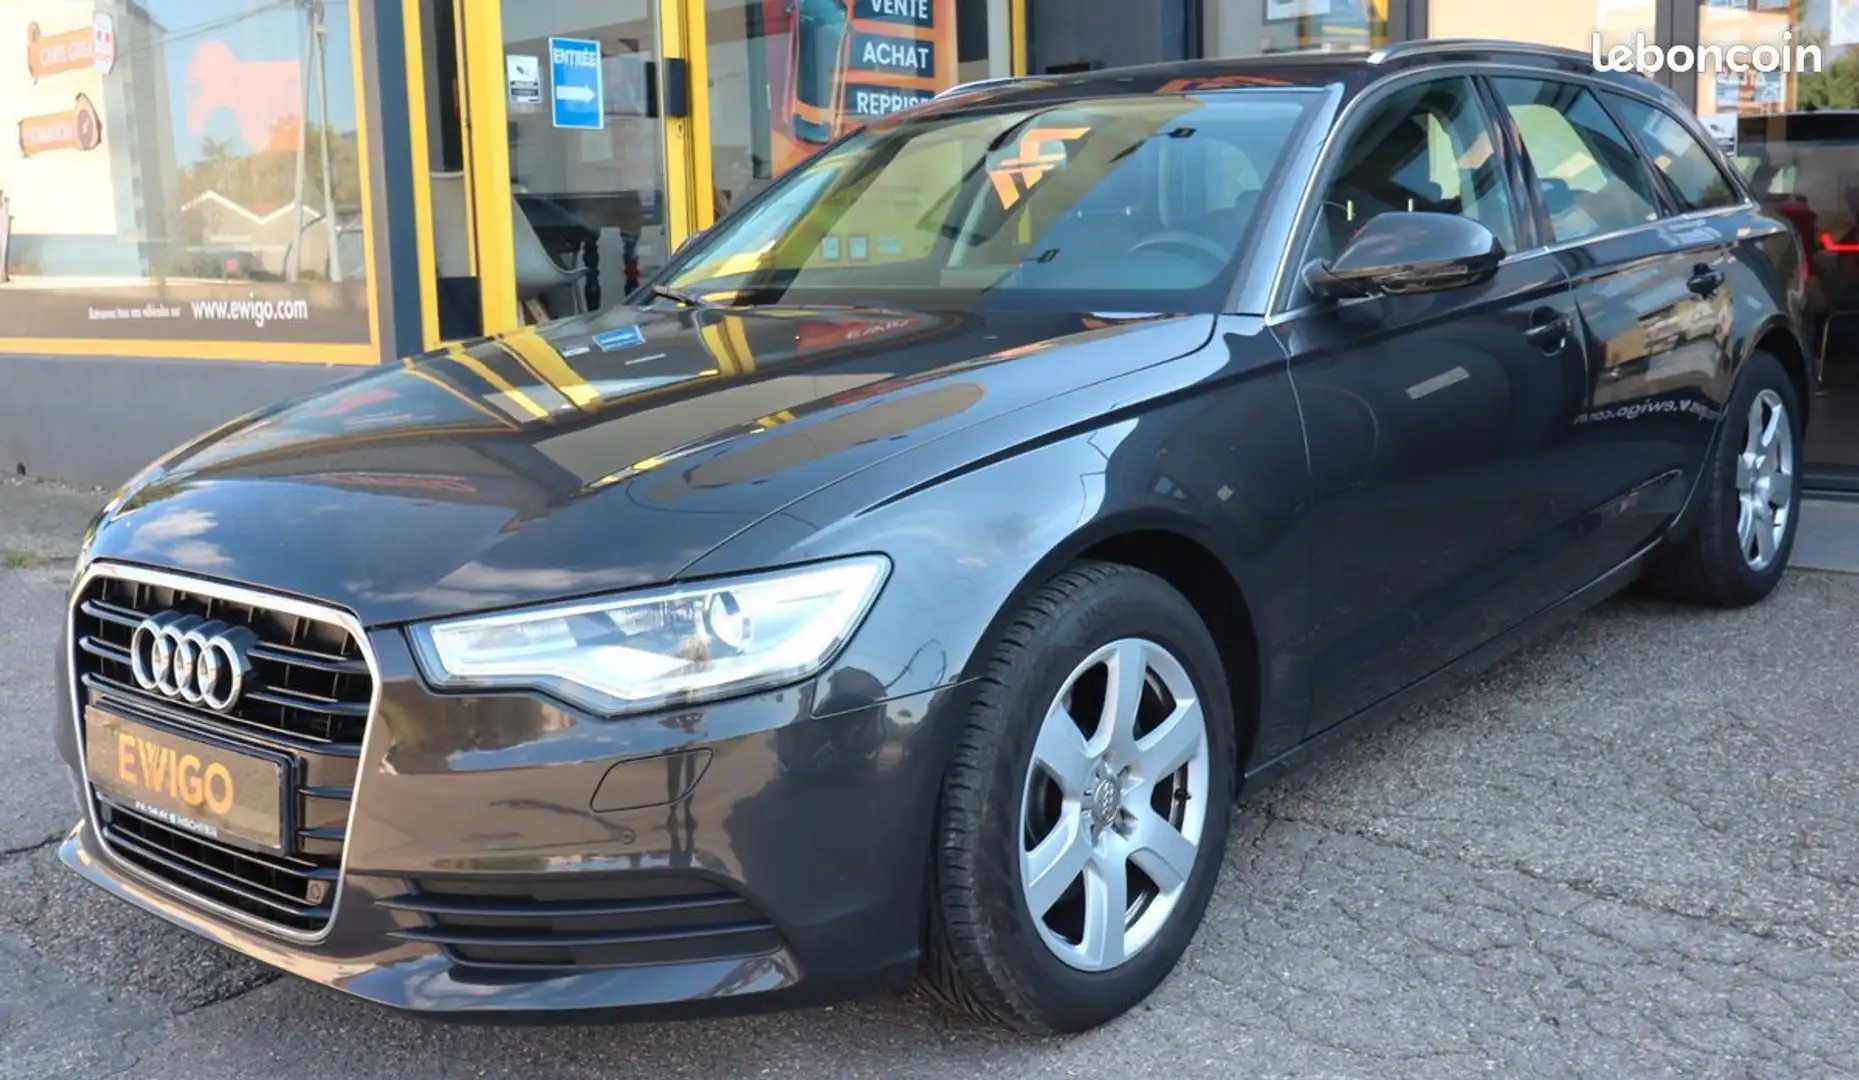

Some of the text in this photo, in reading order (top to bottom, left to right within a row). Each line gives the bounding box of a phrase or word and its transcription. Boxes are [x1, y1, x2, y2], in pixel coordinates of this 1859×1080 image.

[871, 0, 929, 19] VENTE
[552, 47, 597, 67] ENTRÉE
[862, 41, 930, 69] ACHAT
[856, 91, 930, 115] REPRI
[191, 292, 308, 327] www.ewigo.com
[118, 732, 234, 814] EWIGO
